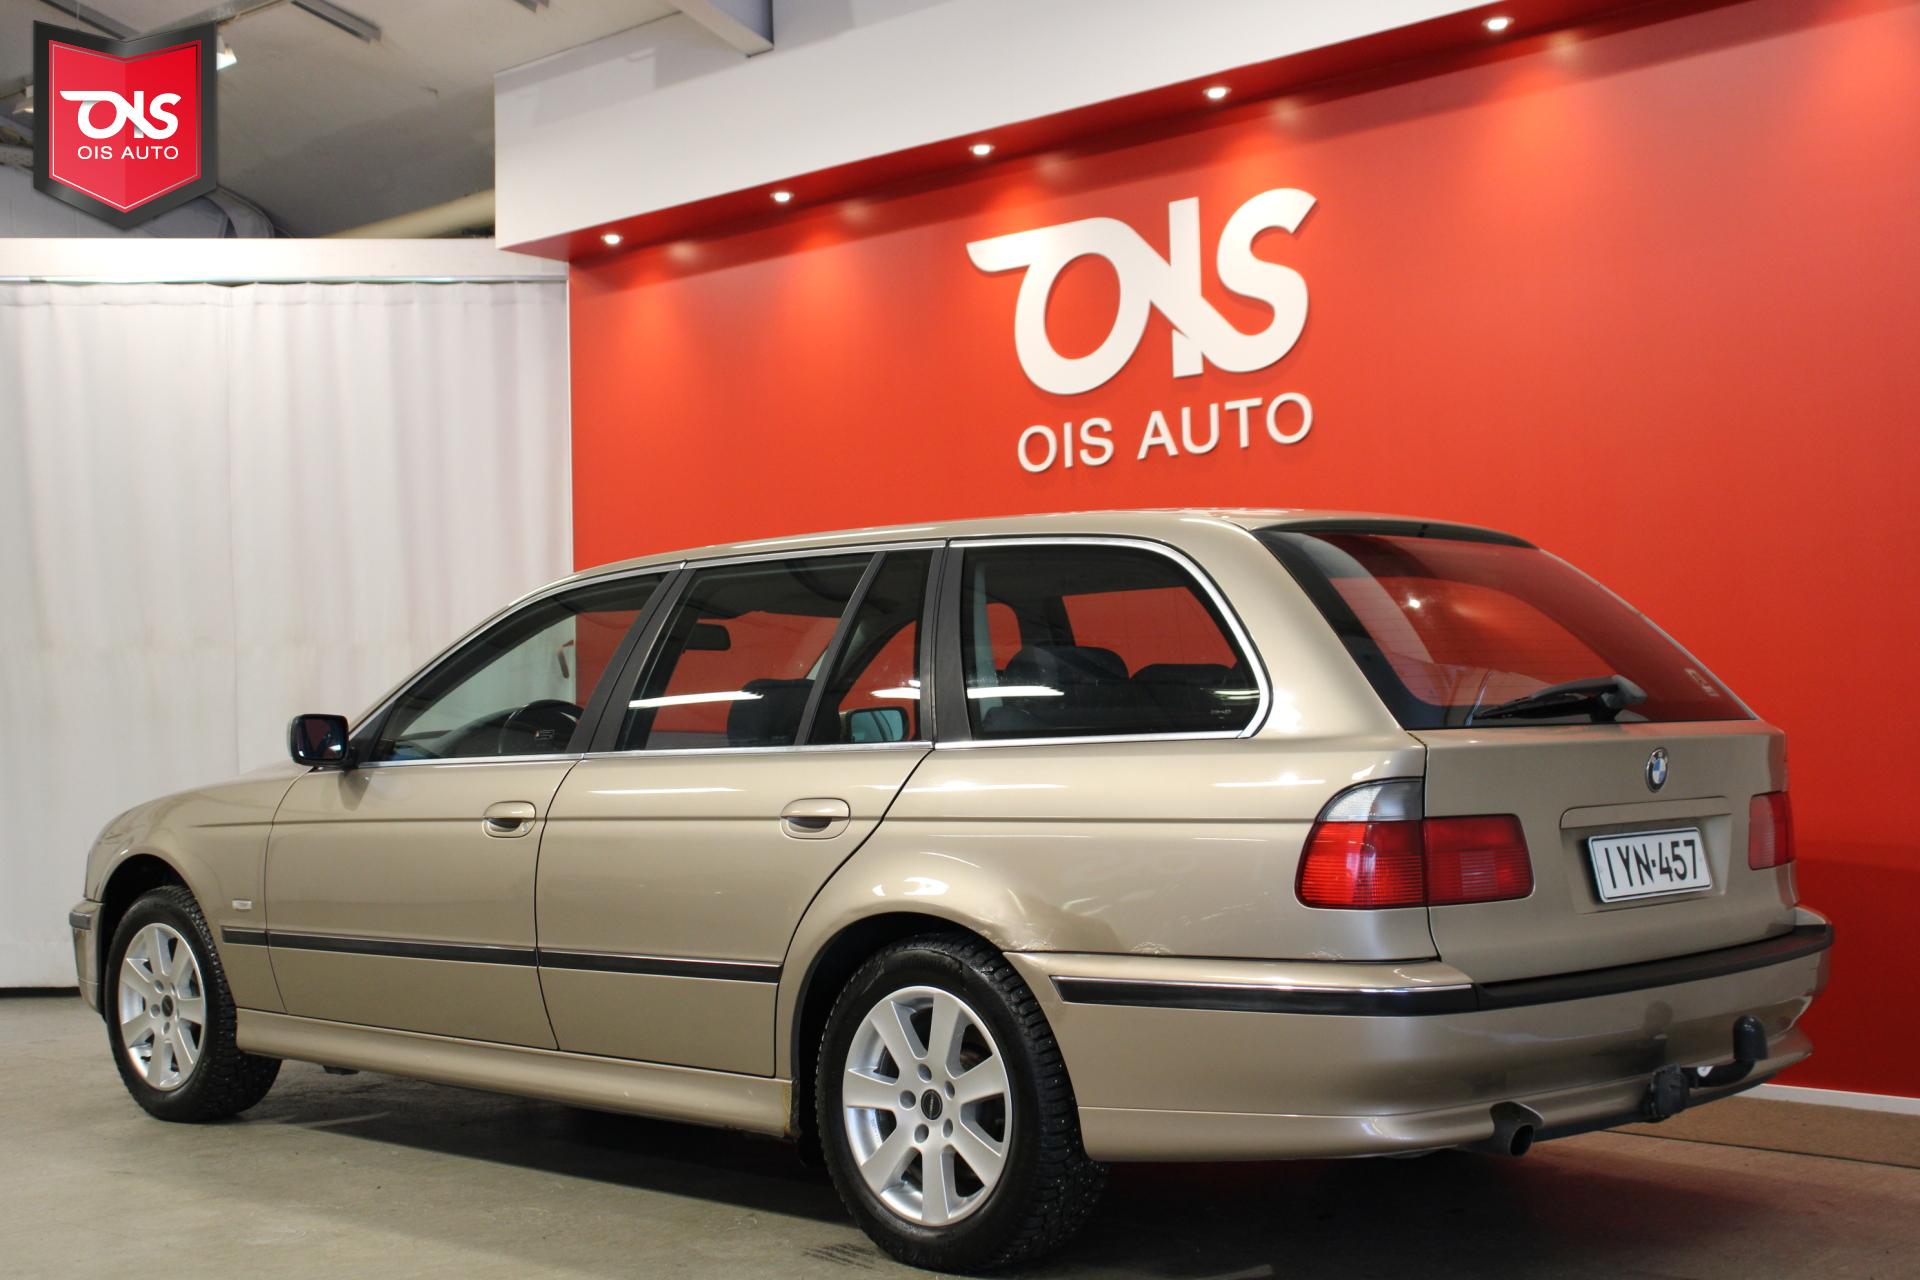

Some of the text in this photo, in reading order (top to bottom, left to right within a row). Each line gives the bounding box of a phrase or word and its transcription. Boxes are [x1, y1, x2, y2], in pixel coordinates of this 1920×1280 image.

[965, 187, 1318, 396] OIS
[1017, 391, 1314, 473] OIS AUTO
